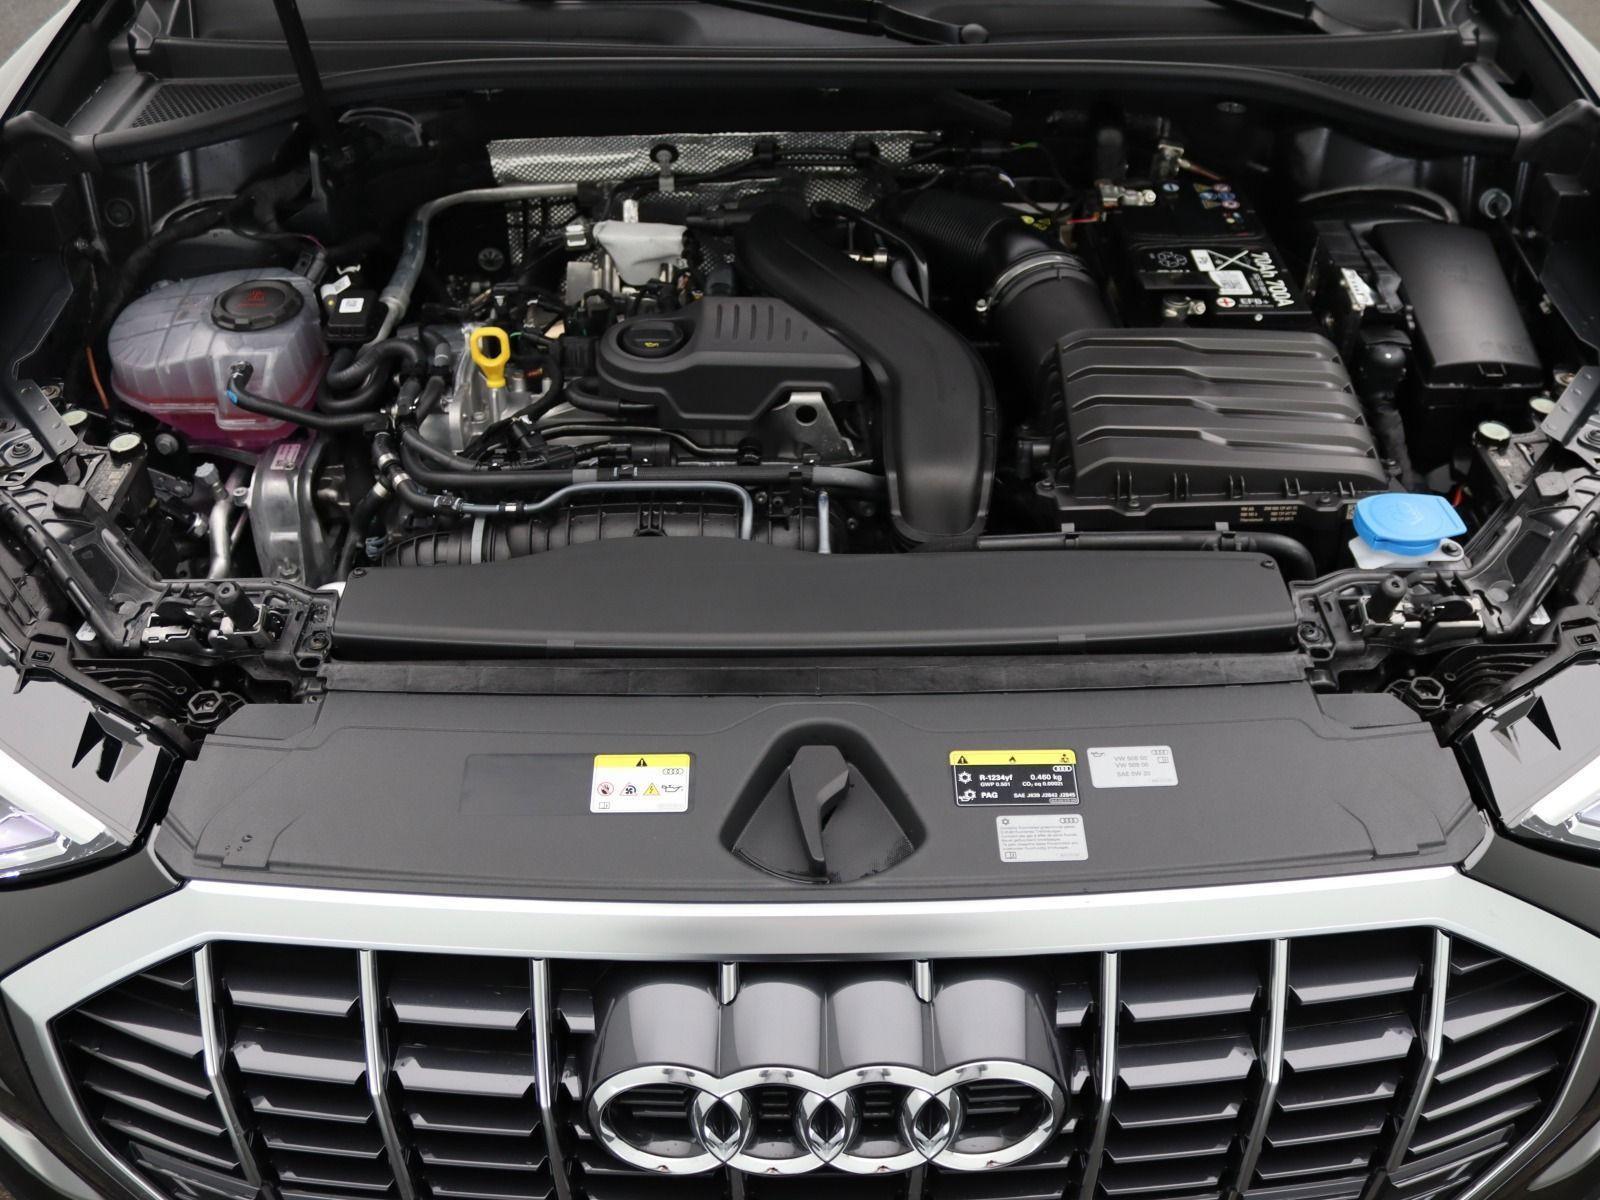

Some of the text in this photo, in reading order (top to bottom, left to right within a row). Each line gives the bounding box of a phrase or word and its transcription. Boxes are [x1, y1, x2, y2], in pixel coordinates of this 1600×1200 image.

[1250, 252, 1279, 278] 70Ah
[1265, 279, 1295, 307] 700A
[979, 774, 1013, 782] R-1234yf
[1053, 774, 1063, 782] kg
